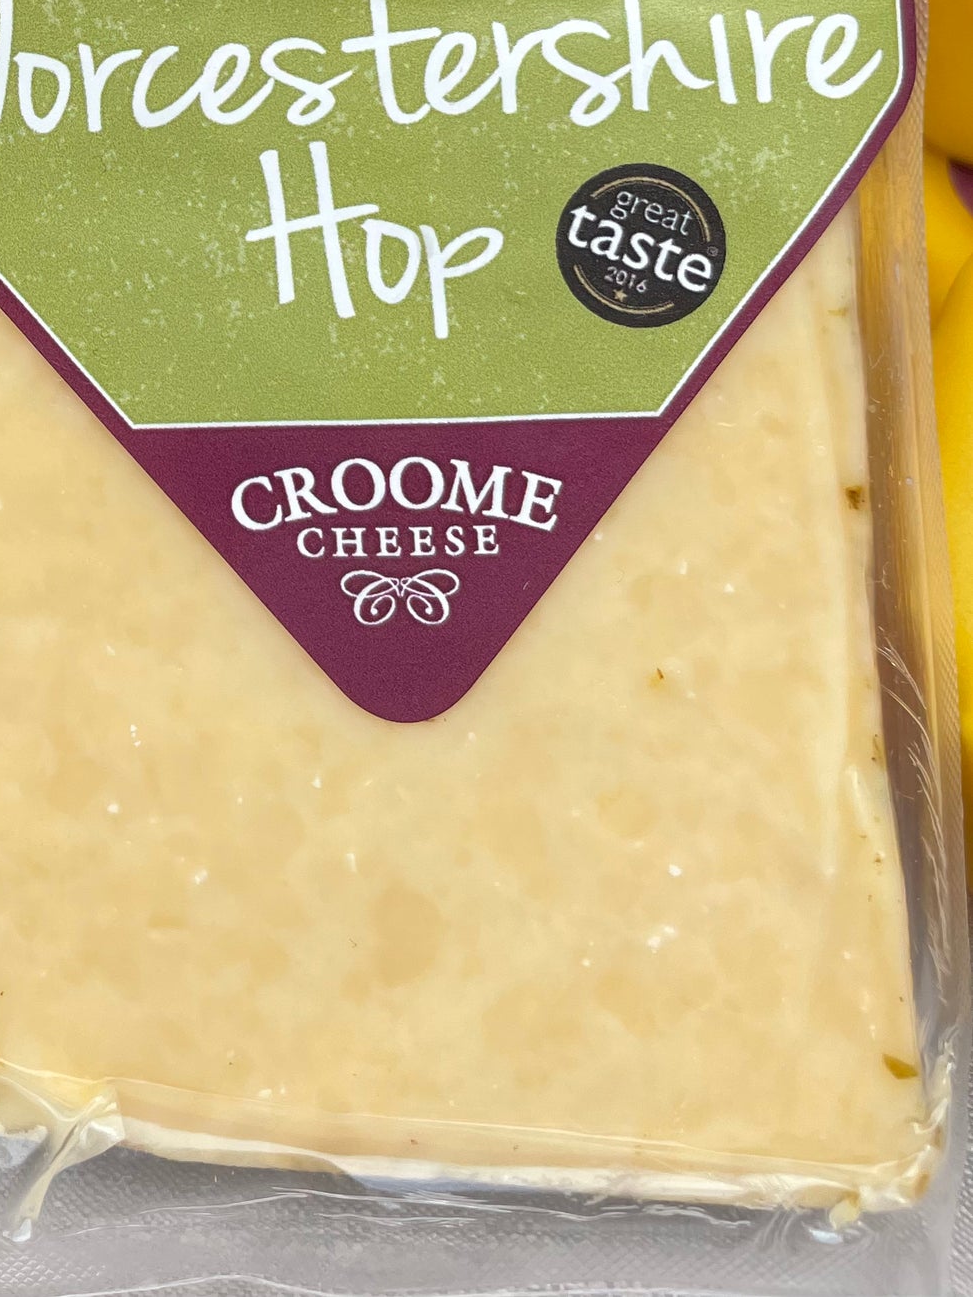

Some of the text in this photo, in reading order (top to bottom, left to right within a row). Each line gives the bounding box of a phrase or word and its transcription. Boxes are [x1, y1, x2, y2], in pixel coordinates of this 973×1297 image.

[246, 140, 503, 340] Hop
[609, 191, 692, 236] great
[568, 205, 712, 293] taste
[604, 266, 647, 293] 2016
[230, 455, 563, 532] CROOME
[296, 524, 500, 558] CHEESE
